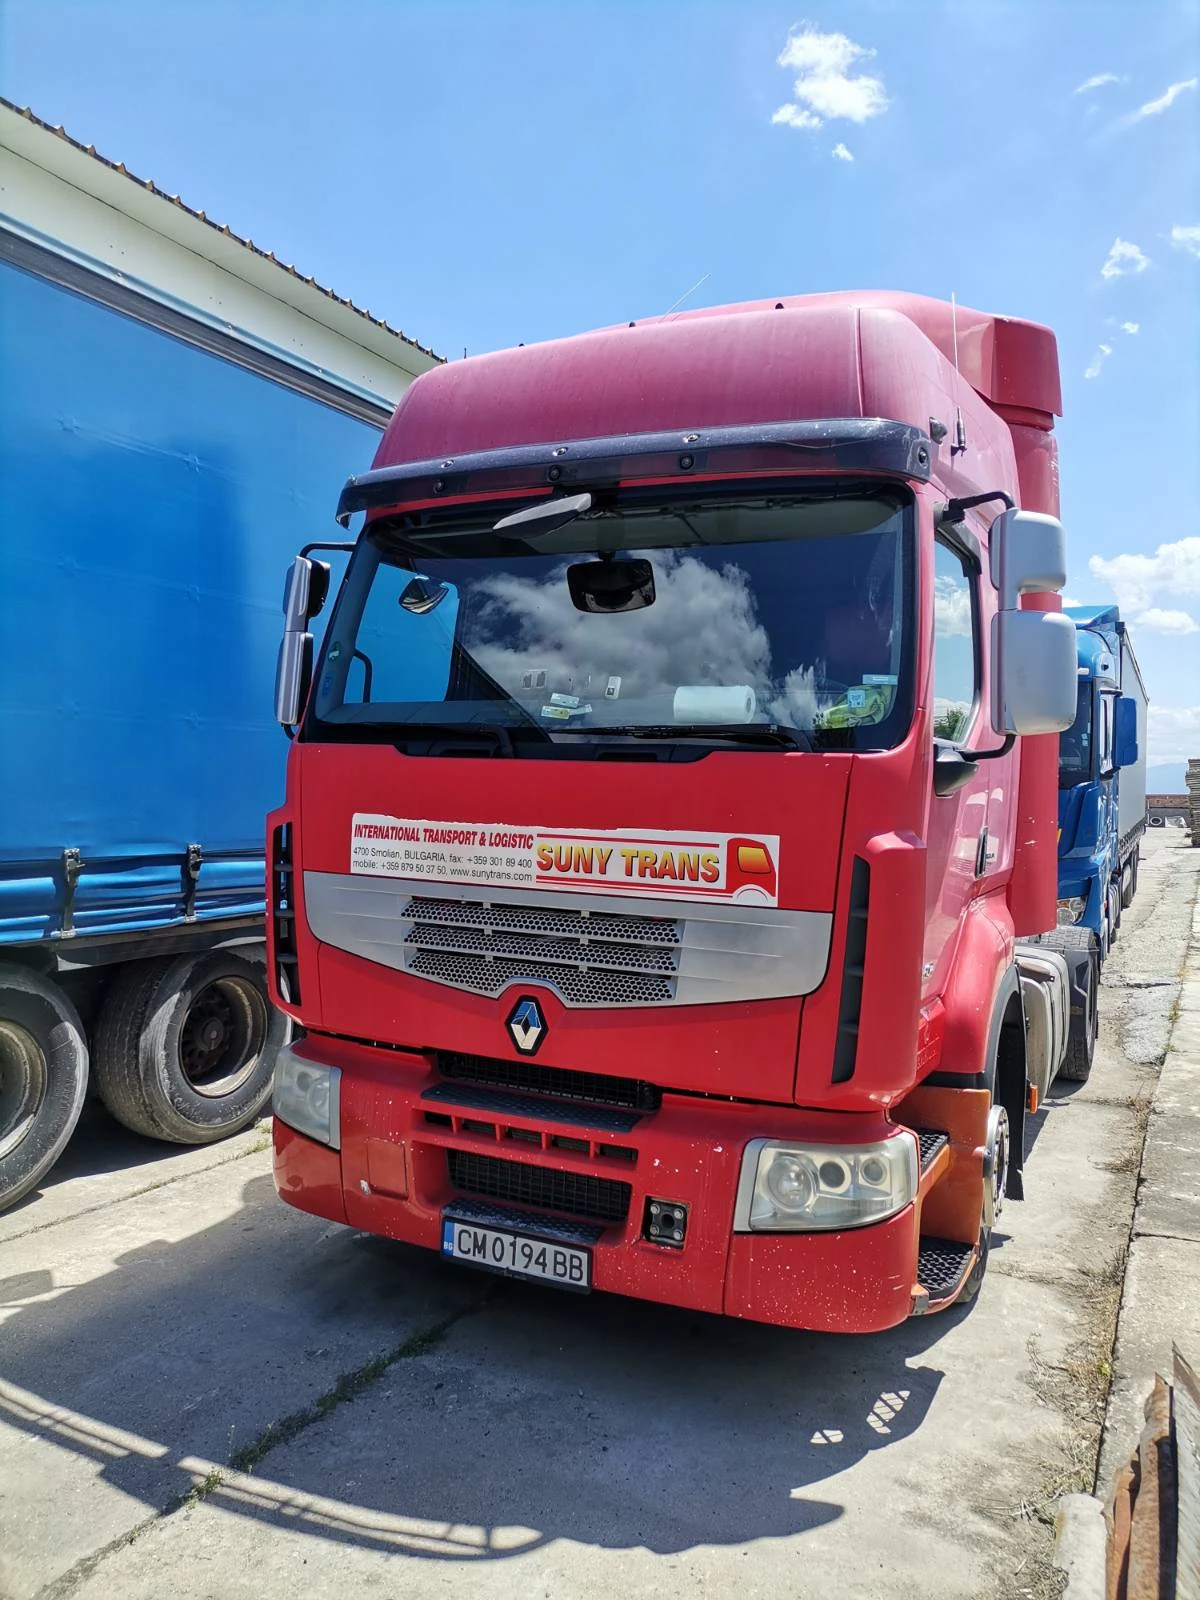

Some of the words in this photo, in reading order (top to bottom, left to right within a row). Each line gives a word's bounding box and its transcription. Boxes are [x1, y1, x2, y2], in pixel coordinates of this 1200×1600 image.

[353, 824, 420, 841] INTERNATIONAL
[423, 828, 477, 846] TRANSPORT
[479, 831, 487, 847] &
[488, 832, 534, 849] LOGISTIC
[353, 846, 369, 856] 4700
[449, 852, 464, 863] fax:
[466, 855, 488, 866] +359
[489, 856, 503, 866] 301
[505, 857, 516, 867] 89
[517, 858, 532, 869] 400
[536, 842, 613, 875] SUNY
[620, 848, 720, 883] TRANS
[352, 859, 378, 869] mobile:
[380, 861, 400, 871] +359
[401, 862, 414, 872] 879
[415, 864, 425, 873] 50
[426, 864, 435, 874] 37
[449, 868, 533, 881] www.sunytrans.com
